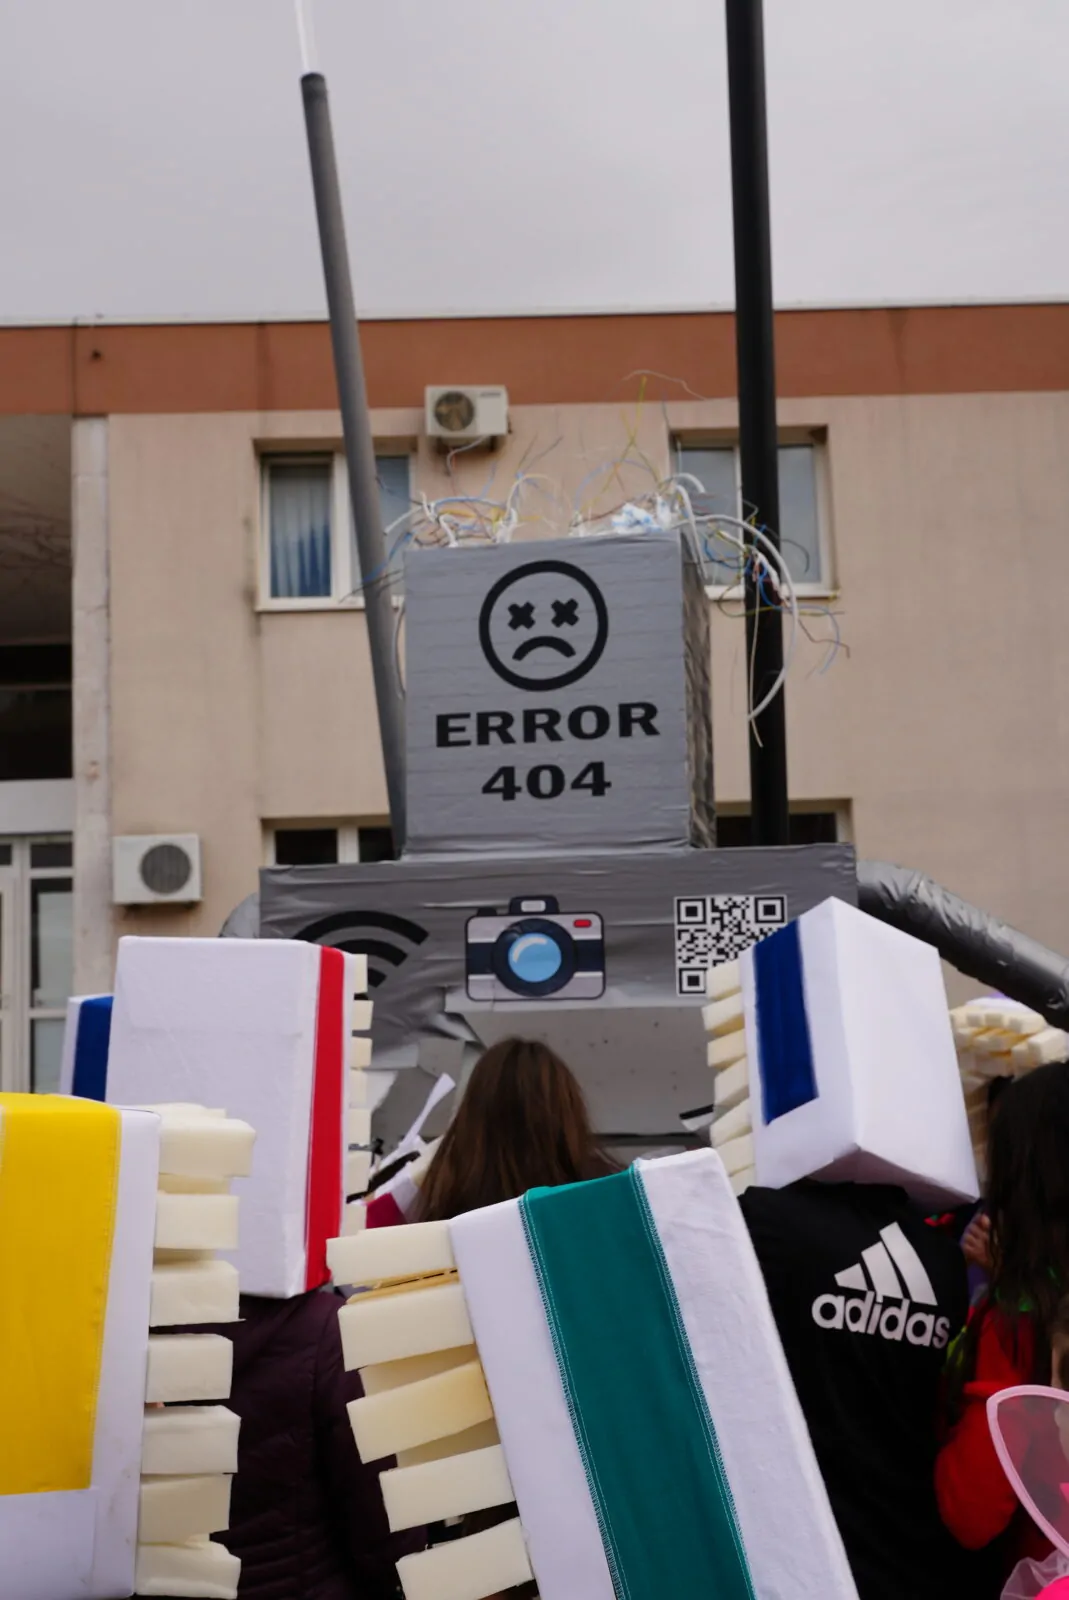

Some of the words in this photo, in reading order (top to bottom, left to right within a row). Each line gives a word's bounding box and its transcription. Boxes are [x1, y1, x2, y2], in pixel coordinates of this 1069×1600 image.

[436, 702, 660, 748] ERROR
[481, 761, 612, 801] 404
[811, 1290, 950, 1348] adidas
